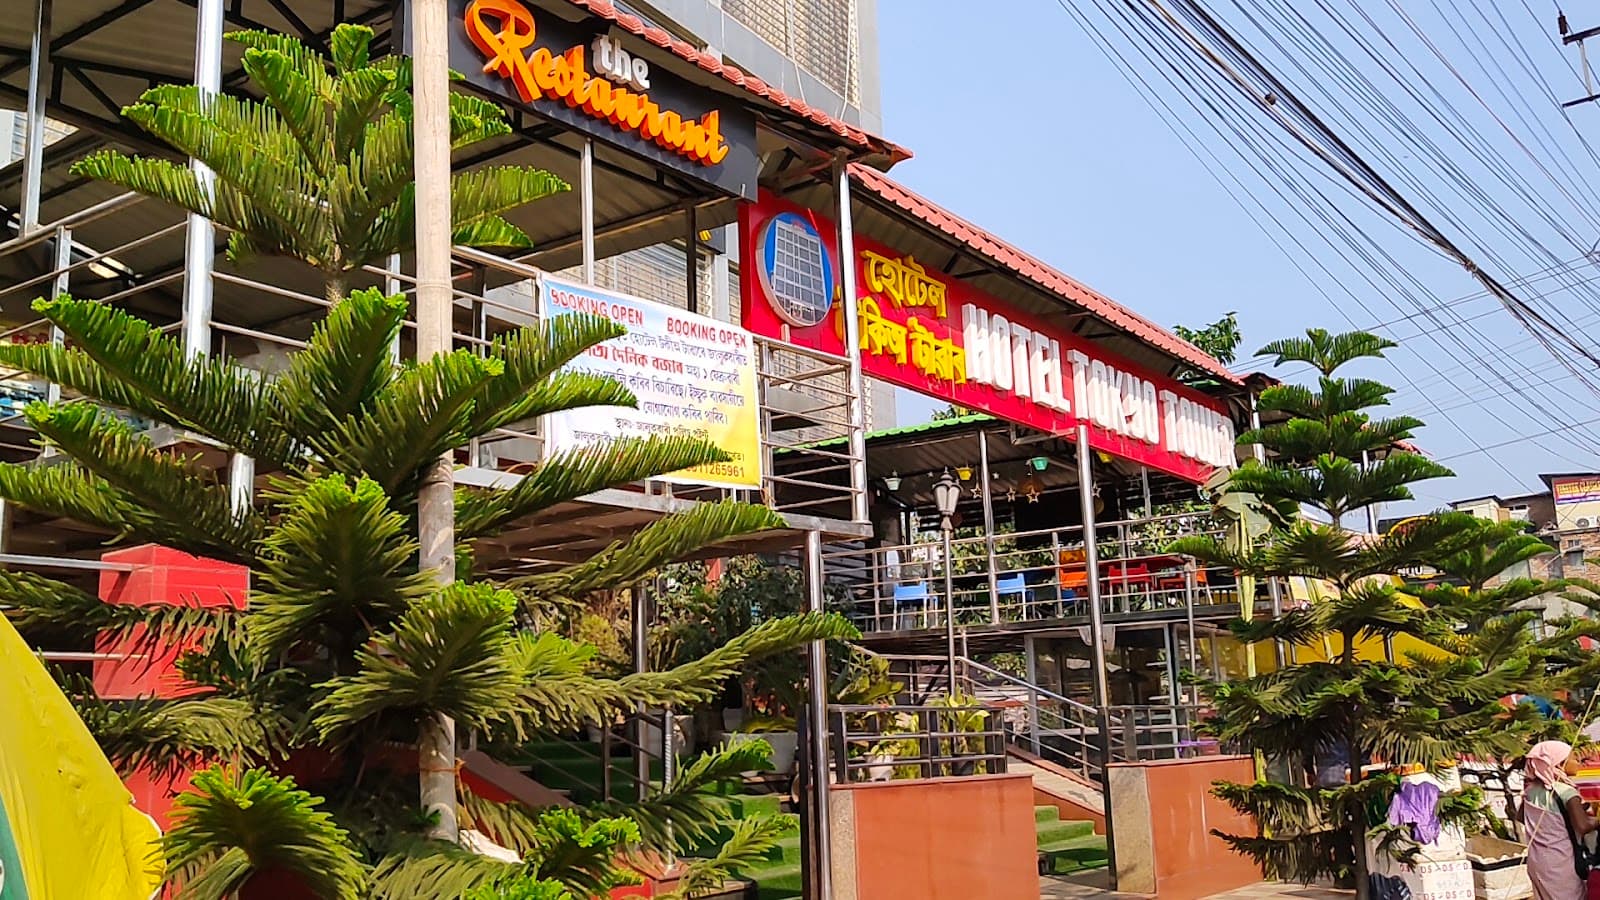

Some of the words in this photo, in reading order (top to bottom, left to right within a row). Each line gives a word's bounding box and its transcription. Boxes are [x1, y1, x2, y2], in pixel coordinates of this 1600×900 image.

[465, 0, 729, 166] Restaurant
[591, 34, 650, 91] the
[551, 288, 608, 317] BOOKING
[611, 304, 643, 325] OPEN
[860, 249, 947, 319] হোটেল
[667, 316, 716, 343] BOOKING
[719, 329, 747, 349] OPEN
[961, 303, 1071, 413] HOTEL
[1066, 348, 1160, 445] TOKYO
